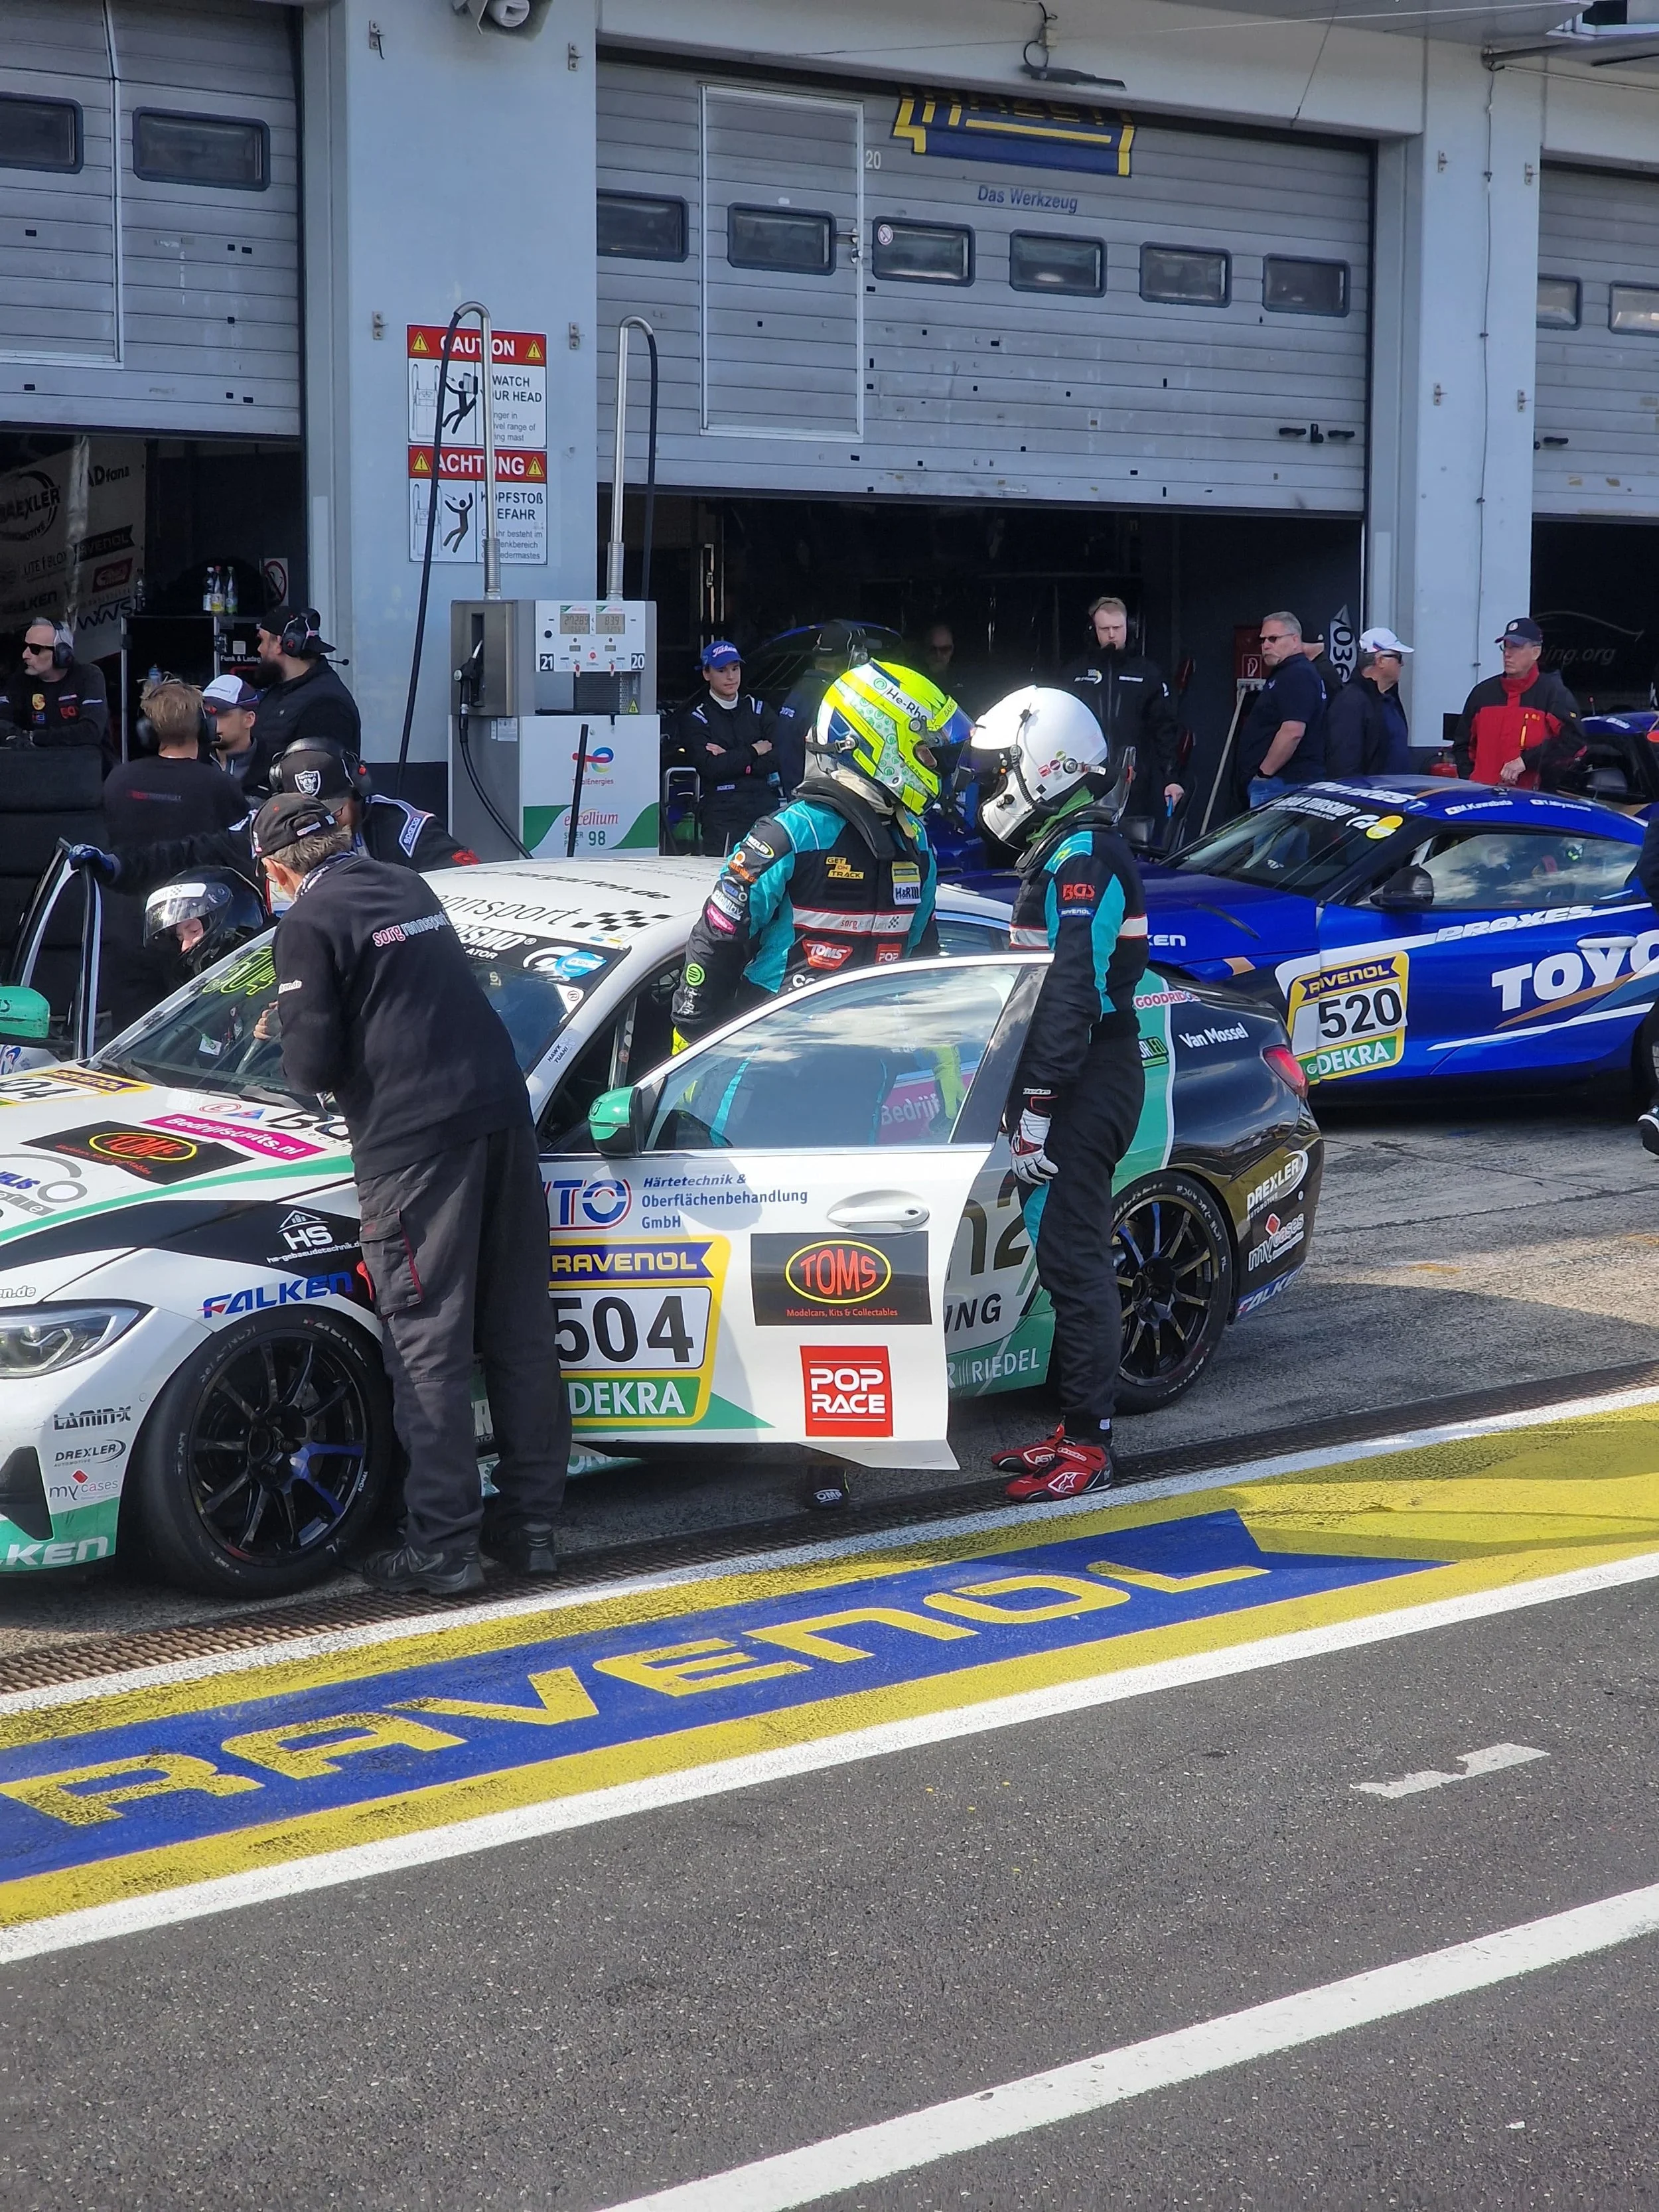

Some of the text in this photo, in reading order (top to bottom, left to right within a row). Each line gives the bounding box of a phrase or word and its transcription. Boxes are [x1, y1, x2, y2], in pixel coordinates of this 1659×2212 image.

[865, 150, 881, 170] 20
[977, 184, 1078, 213] Das Werkzeug
[440, 335, 515, 356] CAUTON
[492, 375, 530, 388] WATCH
[513, 391, 542, 403] HEAD
[507, 423, 530, 432] range
[531, 423, 537, 431] of
[439, 453, 525, 475] ACHTNG
[480, 491, 543, 504] KPFSTOß
[497, 508, 536, 521] EFAHR
[540, 656, 553, 670] 21
[631, 654, 645, 670] 20
[571, 778, 614, 786] TalEnergies
[563, 811, 618, 826] ecellium
[403, 817, 421, 844] sparco
[588, 830, 606, 846] 98
[1062, 883, 1095, 900] BGS
[840, 919, 858, 930] sorg
[1435, 905, 1594, 943] PROXES
[465, 948, 498, 960] ATOR
[806, 944, 847, 959] TOMS
[1307, 964, 1391, 995] RAVENOL
[1319, 986, 1403, 1039] 520
[1179, 1022, 1250, 1049] Van Mossel
[547, 1044, 562, 1063] HAWK
[1316, 1040, 1391, 1074] DEKRA
[165, 1117, 306, 1155] BedrijfsUnits.nl
[643, 1173, 747, 1188] Härtetechnik &
[1247, 1157, 1300, 1212] DREXLER
[641, 1189, 808, 1208] Oberflächenbehandlung
[641, 1216, 682, 1228] GmbH
[283, 1225, 333, 1250] HS
[266, 1241, 360, 1264] hs-gebaeudetechnik.d
[551, 1251, 697, 1273] RAVENOL
[800, 1248, 877, 1296] TOMS
[201, 1271, 354, 1319] FALKEN
[786, 1307, 898, 1318] Modelcars, Kits & Collectables
[553, 1295, 694, 1364] 504
[971, 1347, 1041, 1384] RIEDEL
[810, 1368, 885, 1392] POP
[569, 1381, 685, 1415] DEKRA
[812, 1394, 886, 1414] RACE
[54, 1443, 117, 1461] DREXLER
[0, 1535, 109, 1567] KEN
[0, 1560, 1271, 1825] RAVENOL
